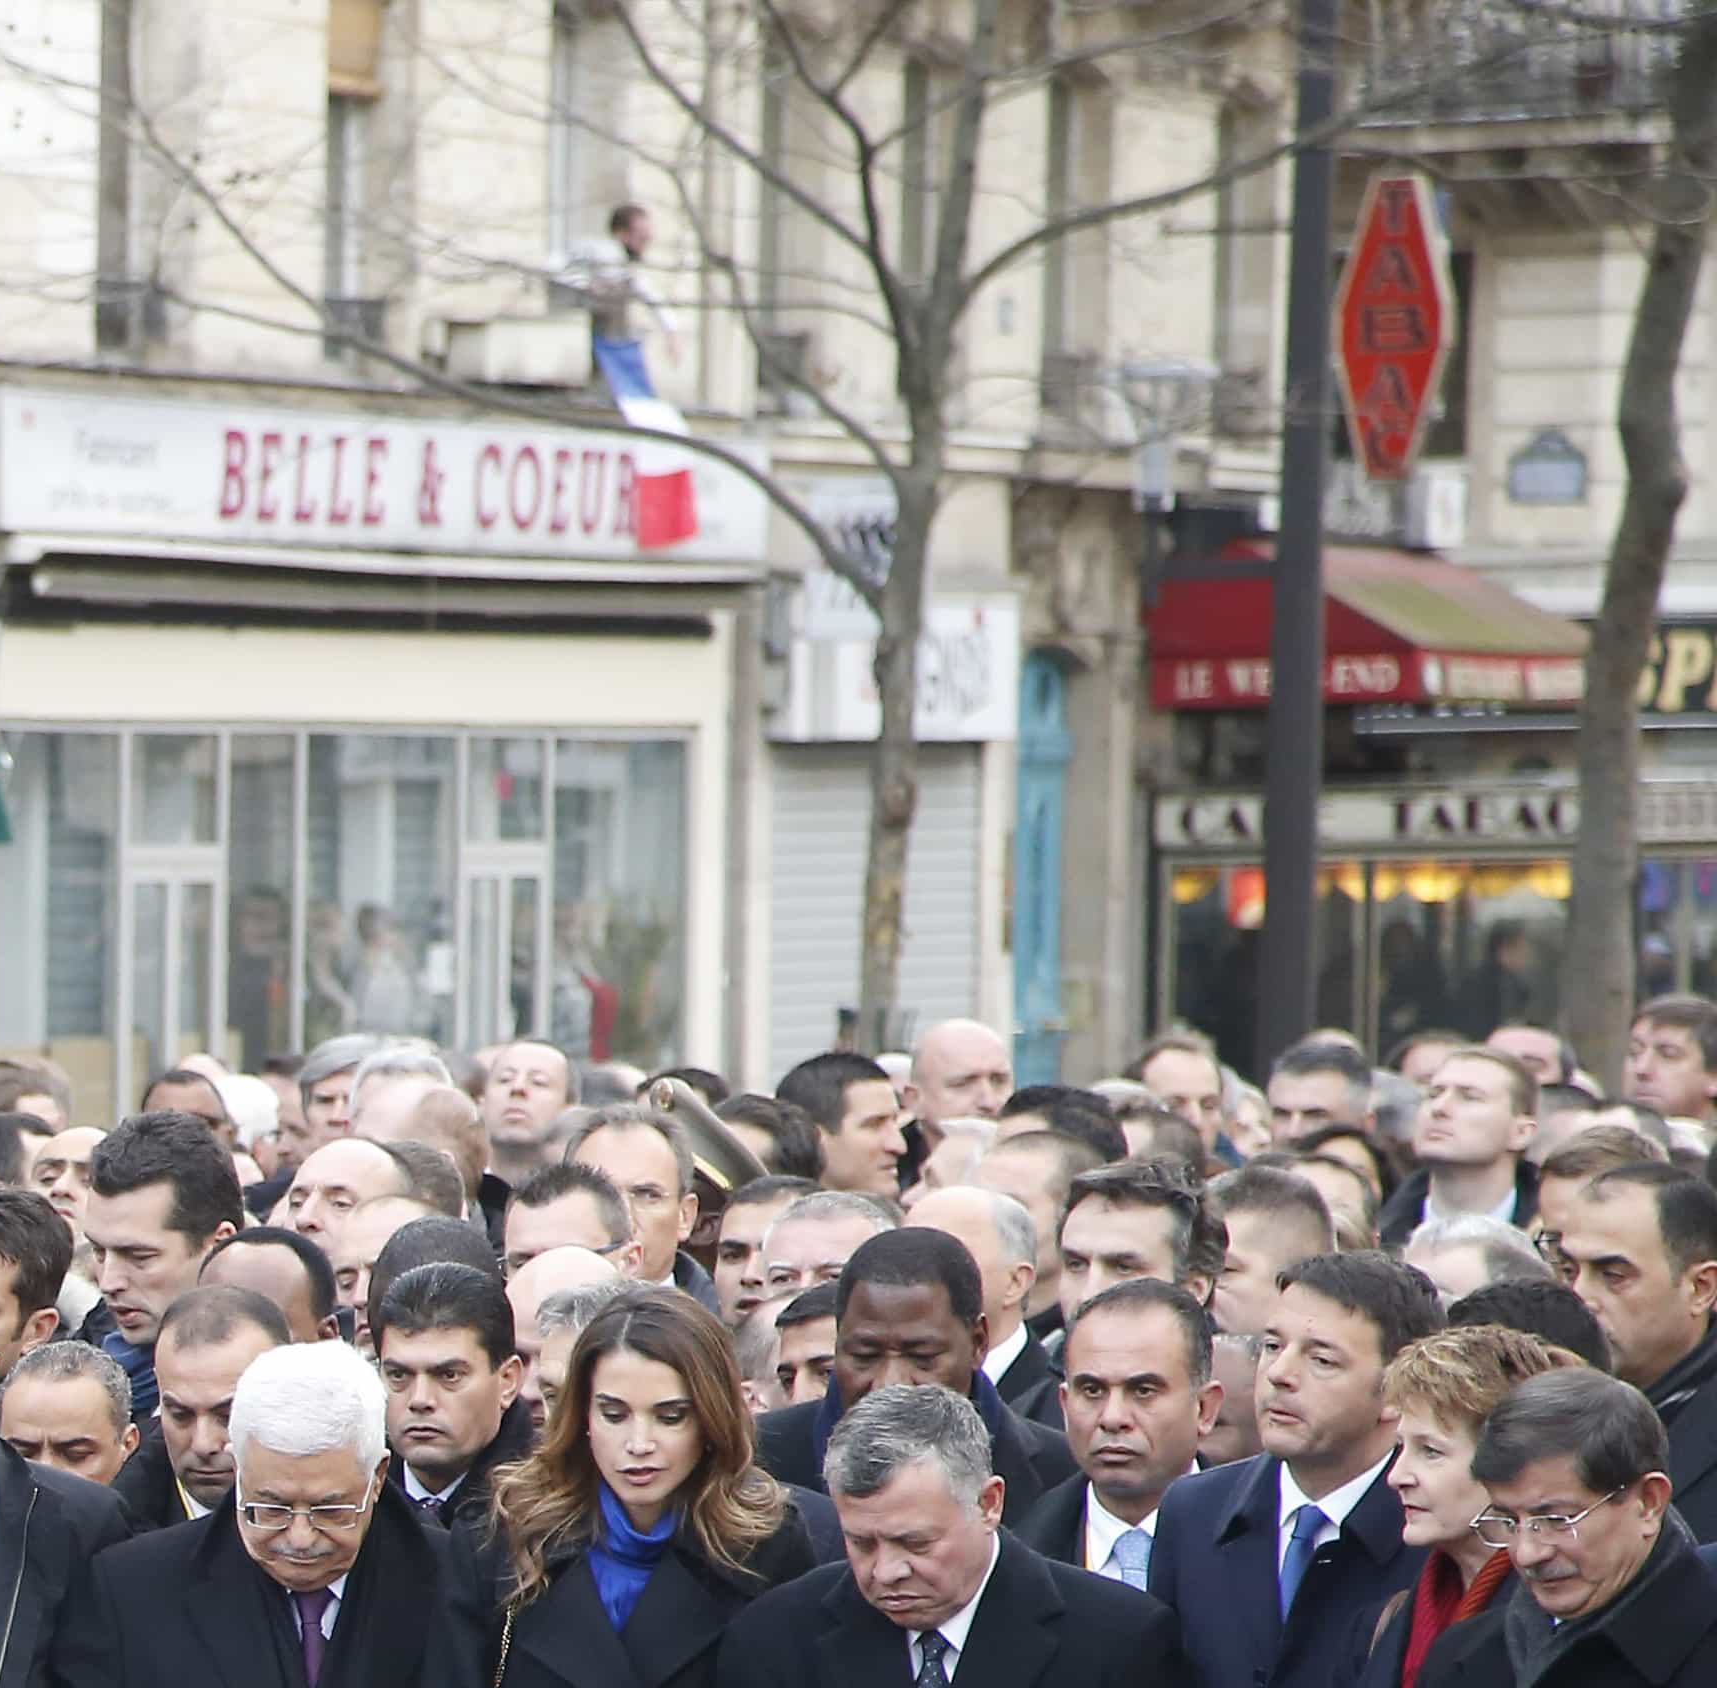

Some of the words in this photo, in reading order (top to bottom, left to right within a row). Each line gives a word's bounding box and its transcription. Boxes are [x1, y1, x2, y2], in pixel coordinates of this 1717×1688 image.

[1361, 182, 1433, 474] TABAC
[219, 430, 389, 525] BELLE
[418, 439, 446, 528] &
[474, 443, 637, 537] COEUR
[1175, 660, 1213, 699] LE
